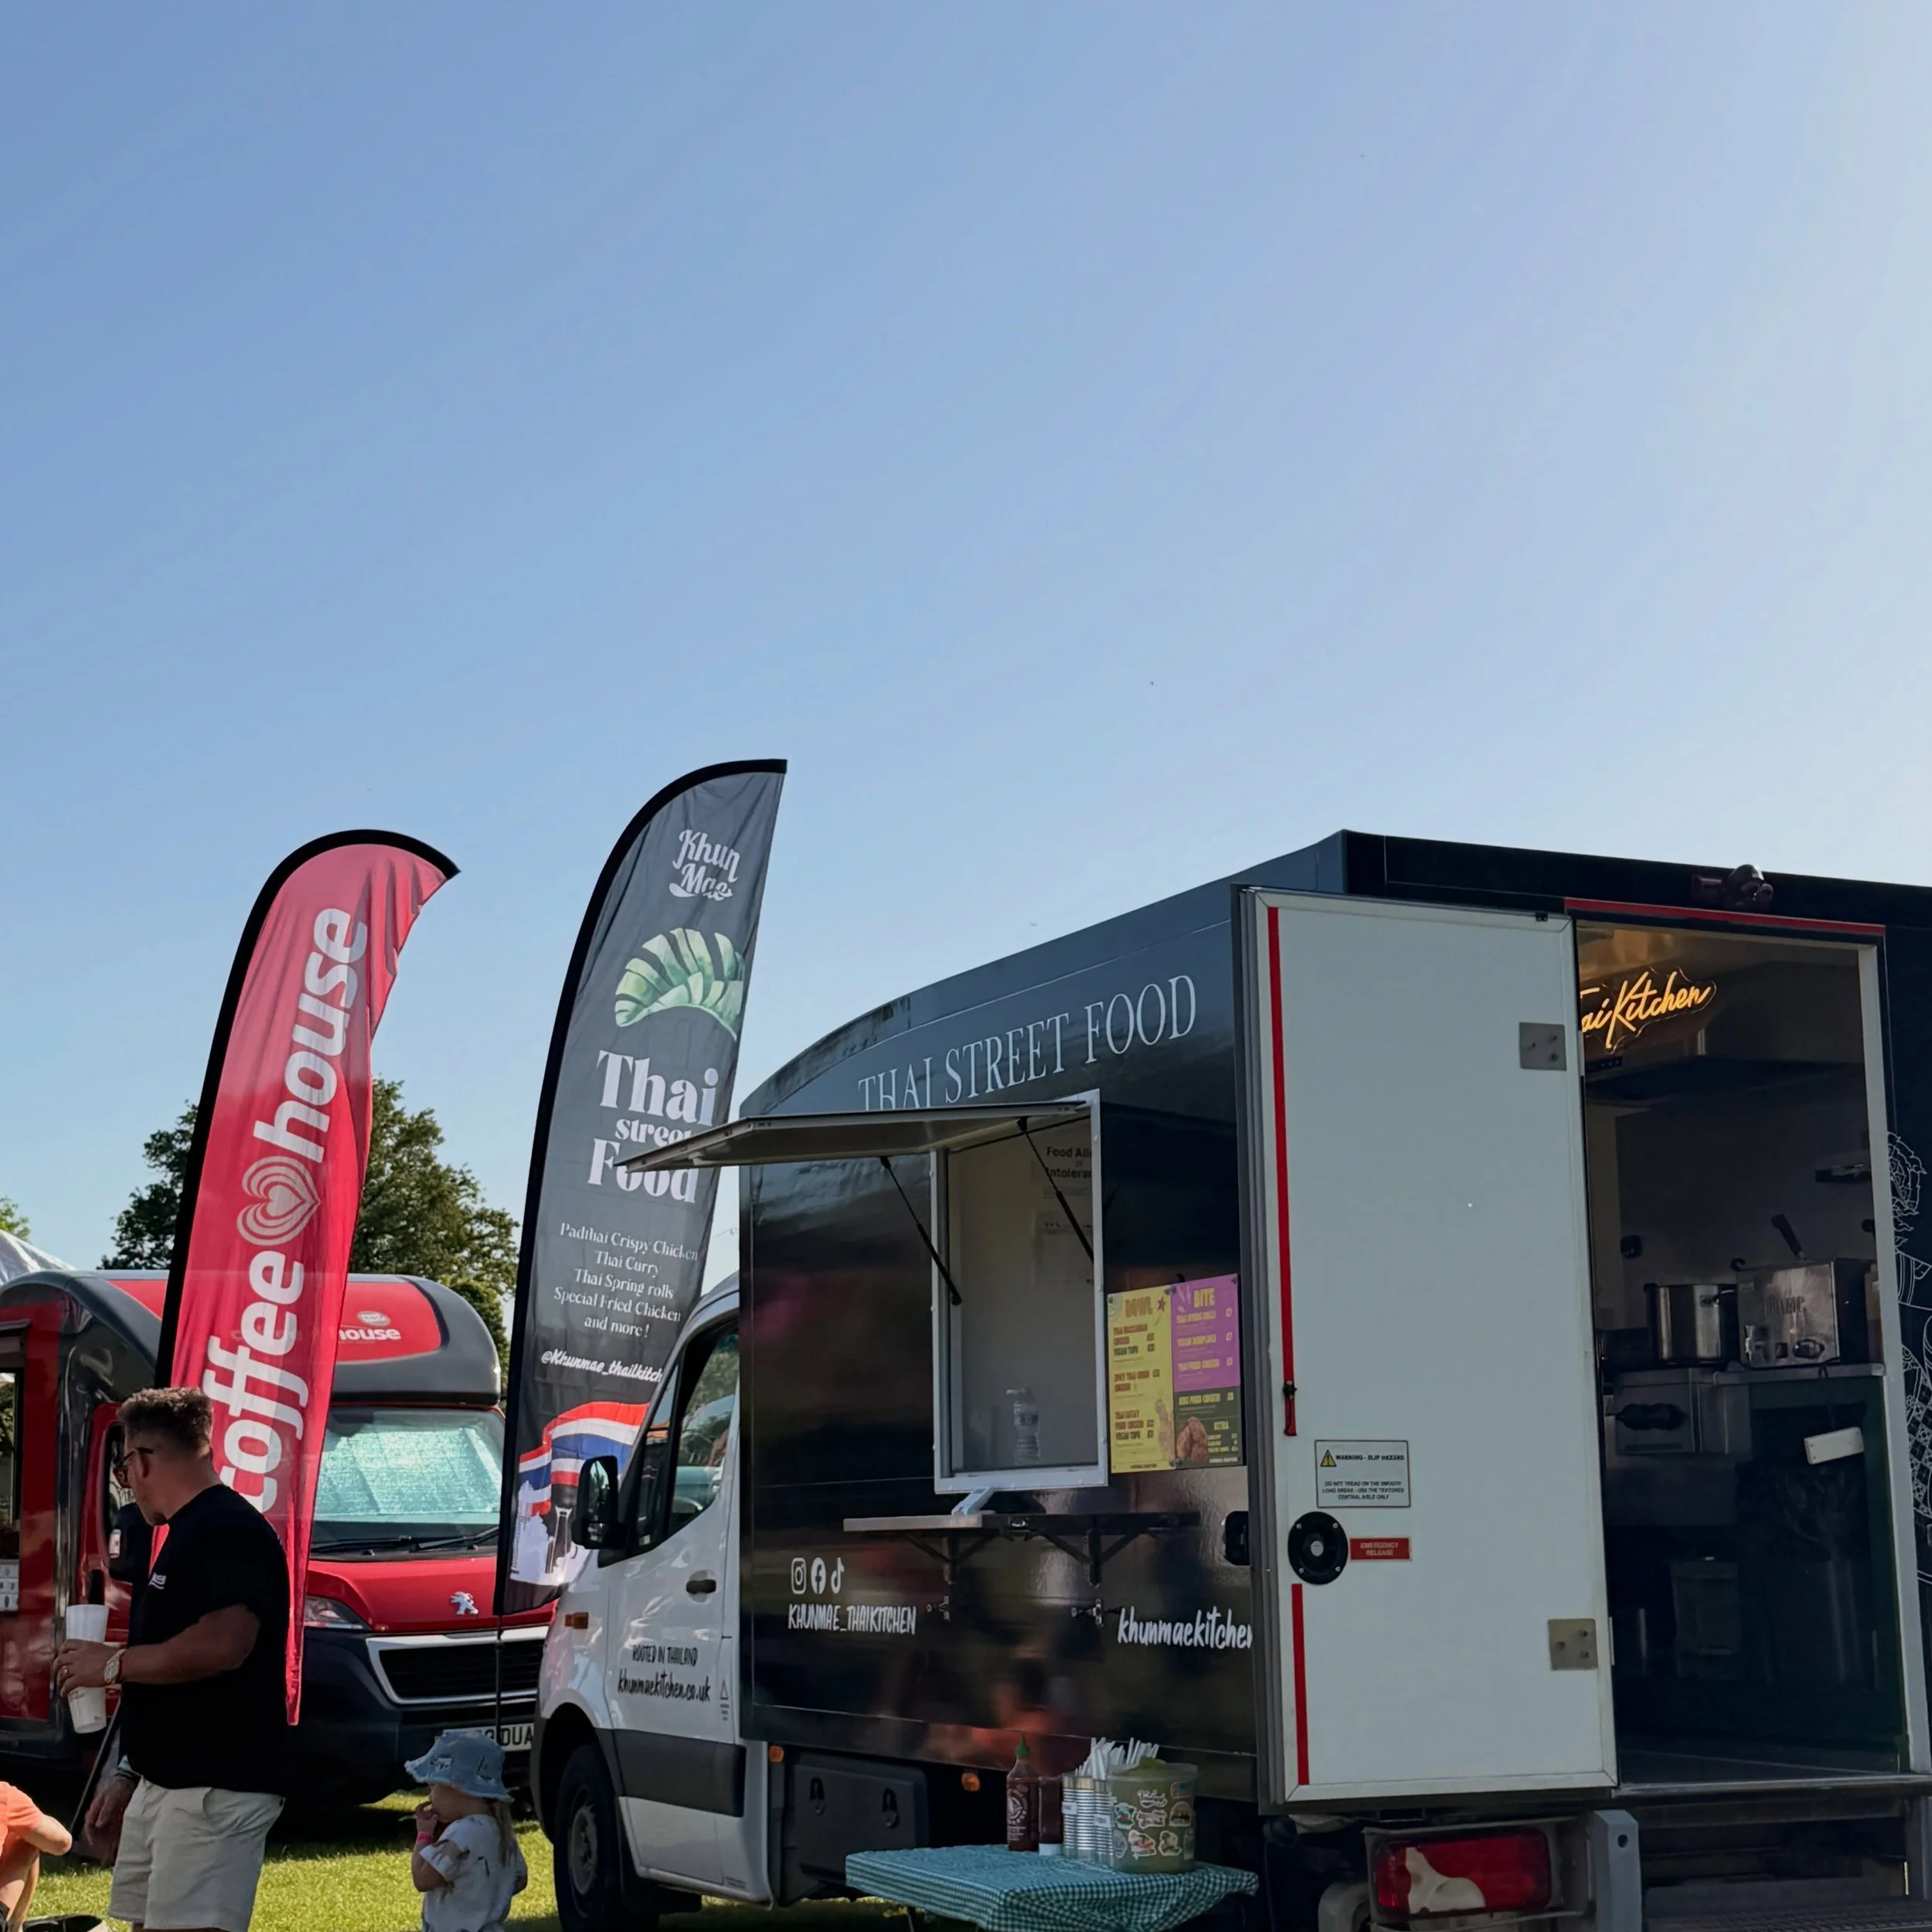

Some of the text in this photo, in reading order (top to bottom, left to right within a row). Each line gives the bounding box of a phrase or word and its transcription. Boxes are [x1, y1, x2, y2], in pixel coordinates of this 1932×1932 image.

[672, 829, 740, 883] Khun
[669, 863, 733, 900] Mae
[944, 1012, 1070, 1104] STREET
[1084, 975, 1196, 1065] FOOD
[597, 1049, 719, 1126] Thai
[588, 1138, 699, 1203] Food
[1046, 1147, 1073, 1157] Food
[202, 909, 366, 1513] coffee house
[560, 1223, 699, 1260] Padthai Crispy Chicken
[594, 1250, 662, 1278] Thai Curry
[575, 1268, 674, 1299] Thai Spring rolls
[554, 1286, 681, 1322] Special Fried Chicken
[583, 1316, 607, 1330] and
[658, 1647, 665, 1664] IN
[667, 1647, 698, 1667] THAILAND
